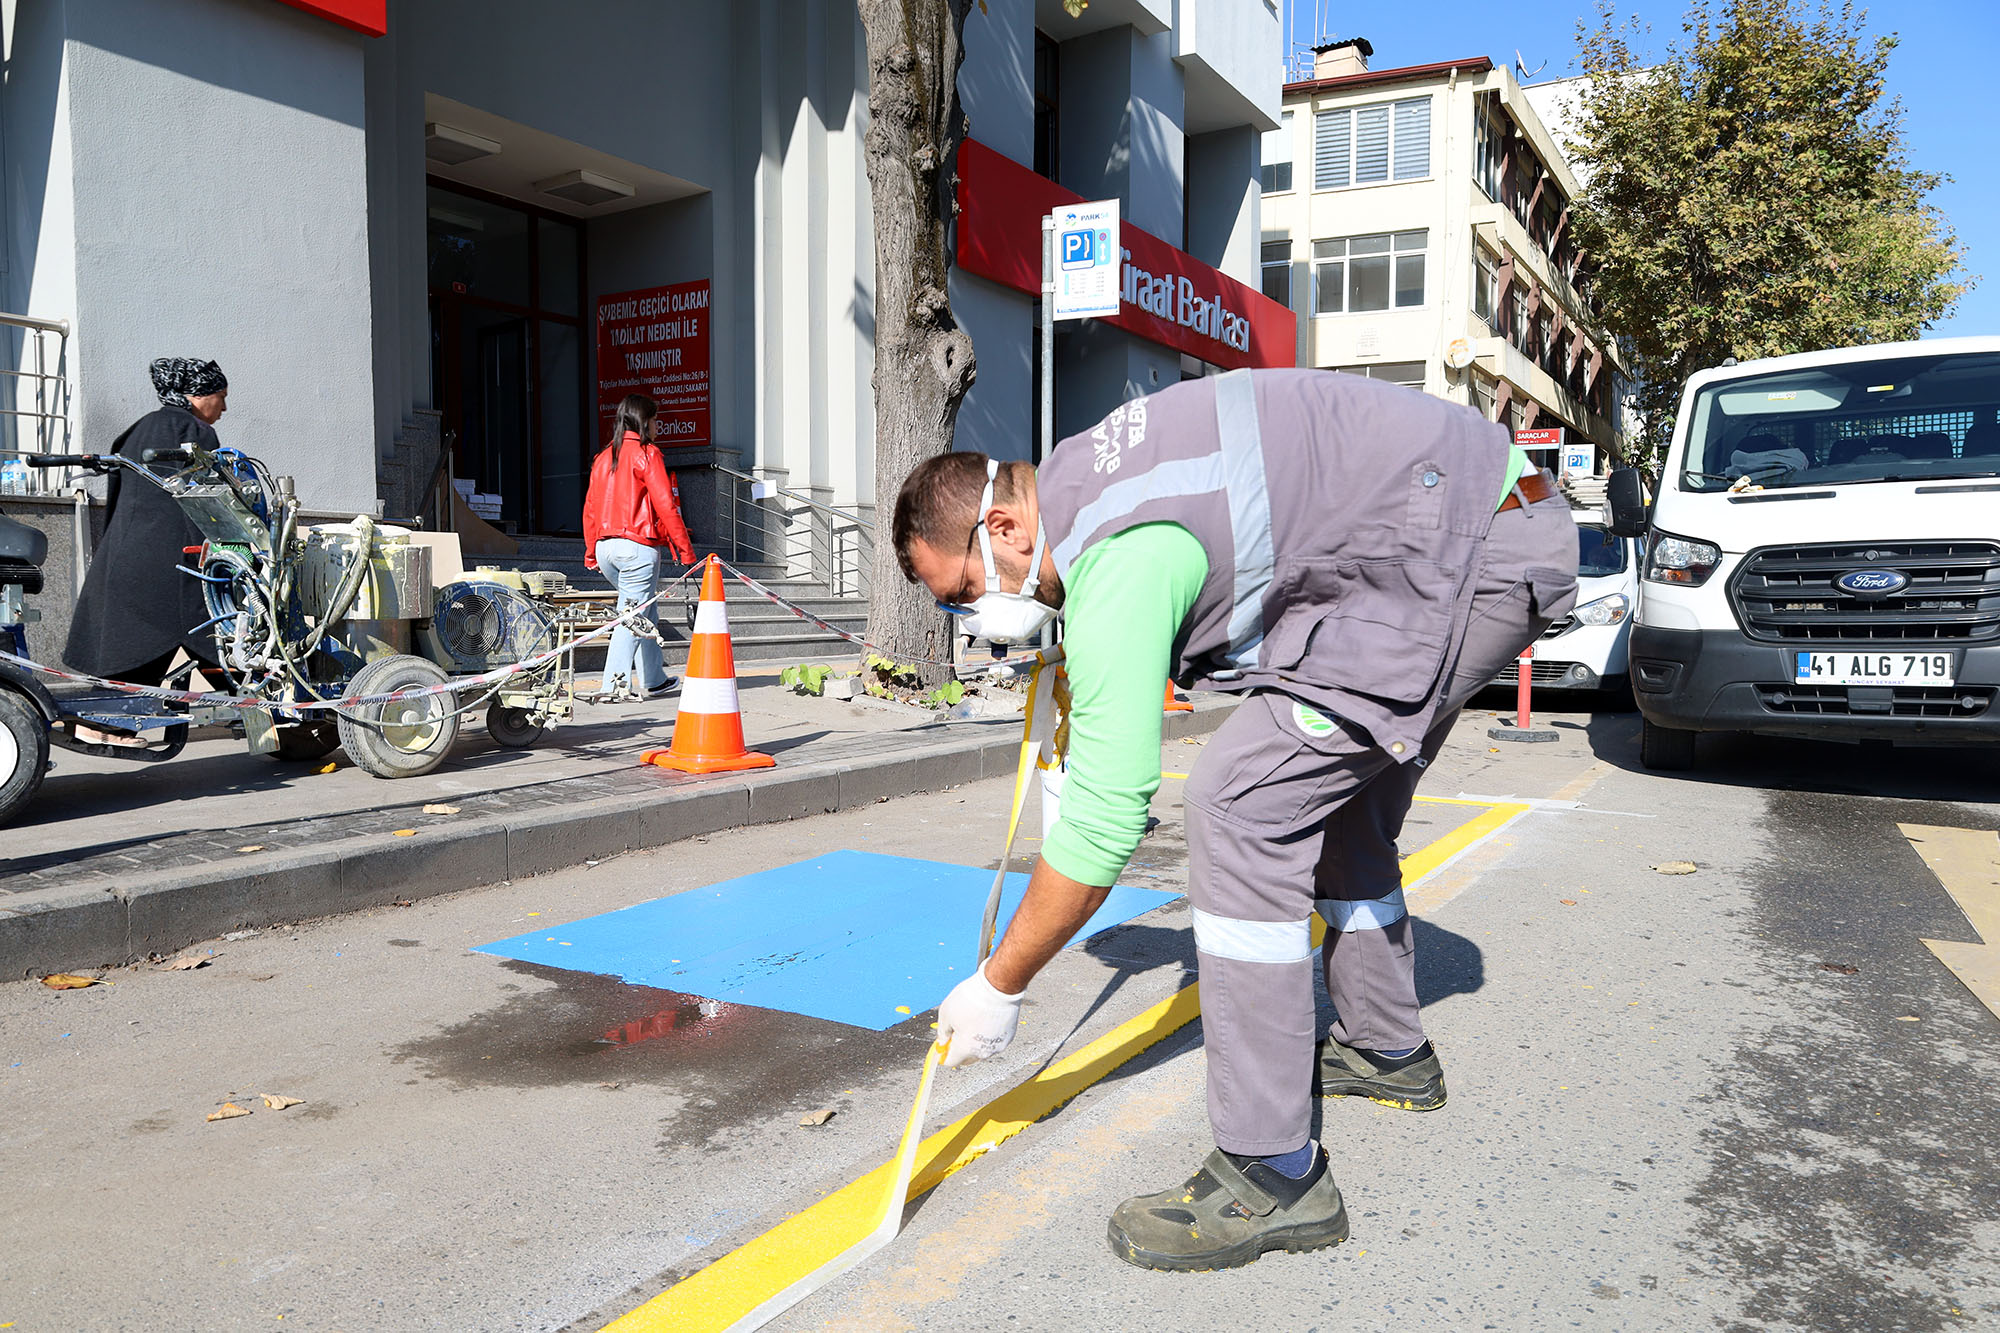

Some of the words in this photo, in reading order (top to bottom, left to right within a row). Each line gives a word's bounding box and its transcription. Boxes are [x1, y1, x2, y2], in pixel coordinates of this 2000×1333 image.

[1066, 235, 1082, 261] P
[599, 297, 638, 326] ŞUBEMİZ
[639, 291, 670, 320] GEÇİCİ
[671, 289, 709, 313] OLARAK
[1177, 276, 1249, 352] Bankası
[610, 323, 645, 347] TADİLAT
[647, 316, 681, 343] NEDENİ
[683, 316, 698, 338] İLE
[624, 348, 682, 374] TAŞINMIŞTIR
[663, 373, 682, 383] Caddesi
[656, 418, 697, 436] Bankası
[1516, 431, 1550, 440] SARAÇLAR
[1851, 573, 1889, 588] Ford
[1811, 655, 1836, 676] 41
[1850, 655, 1892, 677] ALG
[1903, 656, 1946, 677] 719
